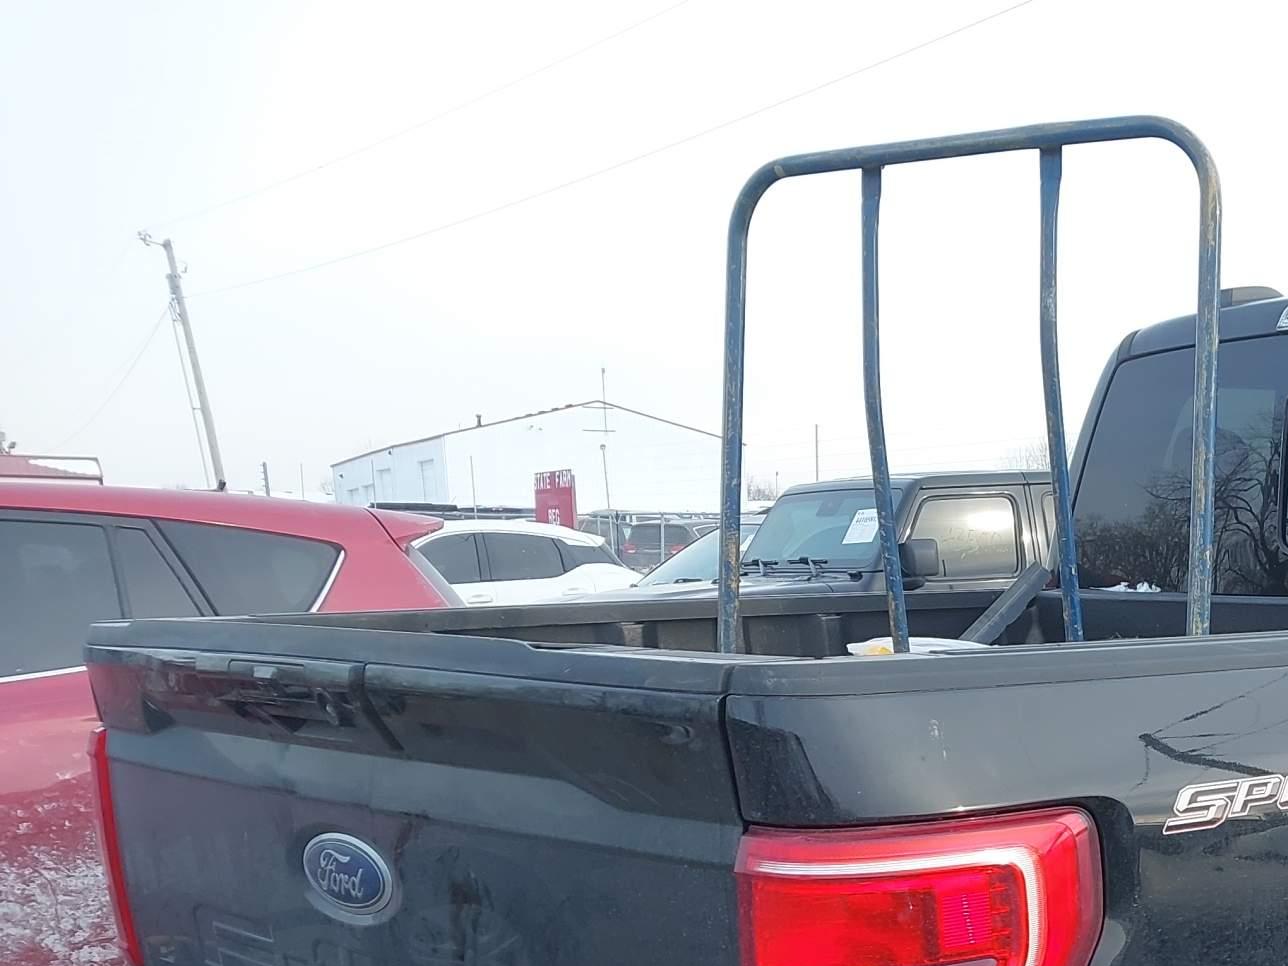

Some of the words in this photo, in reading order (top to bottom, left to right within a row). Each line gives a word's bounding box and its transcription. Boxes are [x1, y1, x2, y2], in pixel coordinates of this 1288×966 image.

[533, 473, 551, 490] STATE
[555, 471, 572, 489] FARM
[317, 849, 364, 898] Ford
